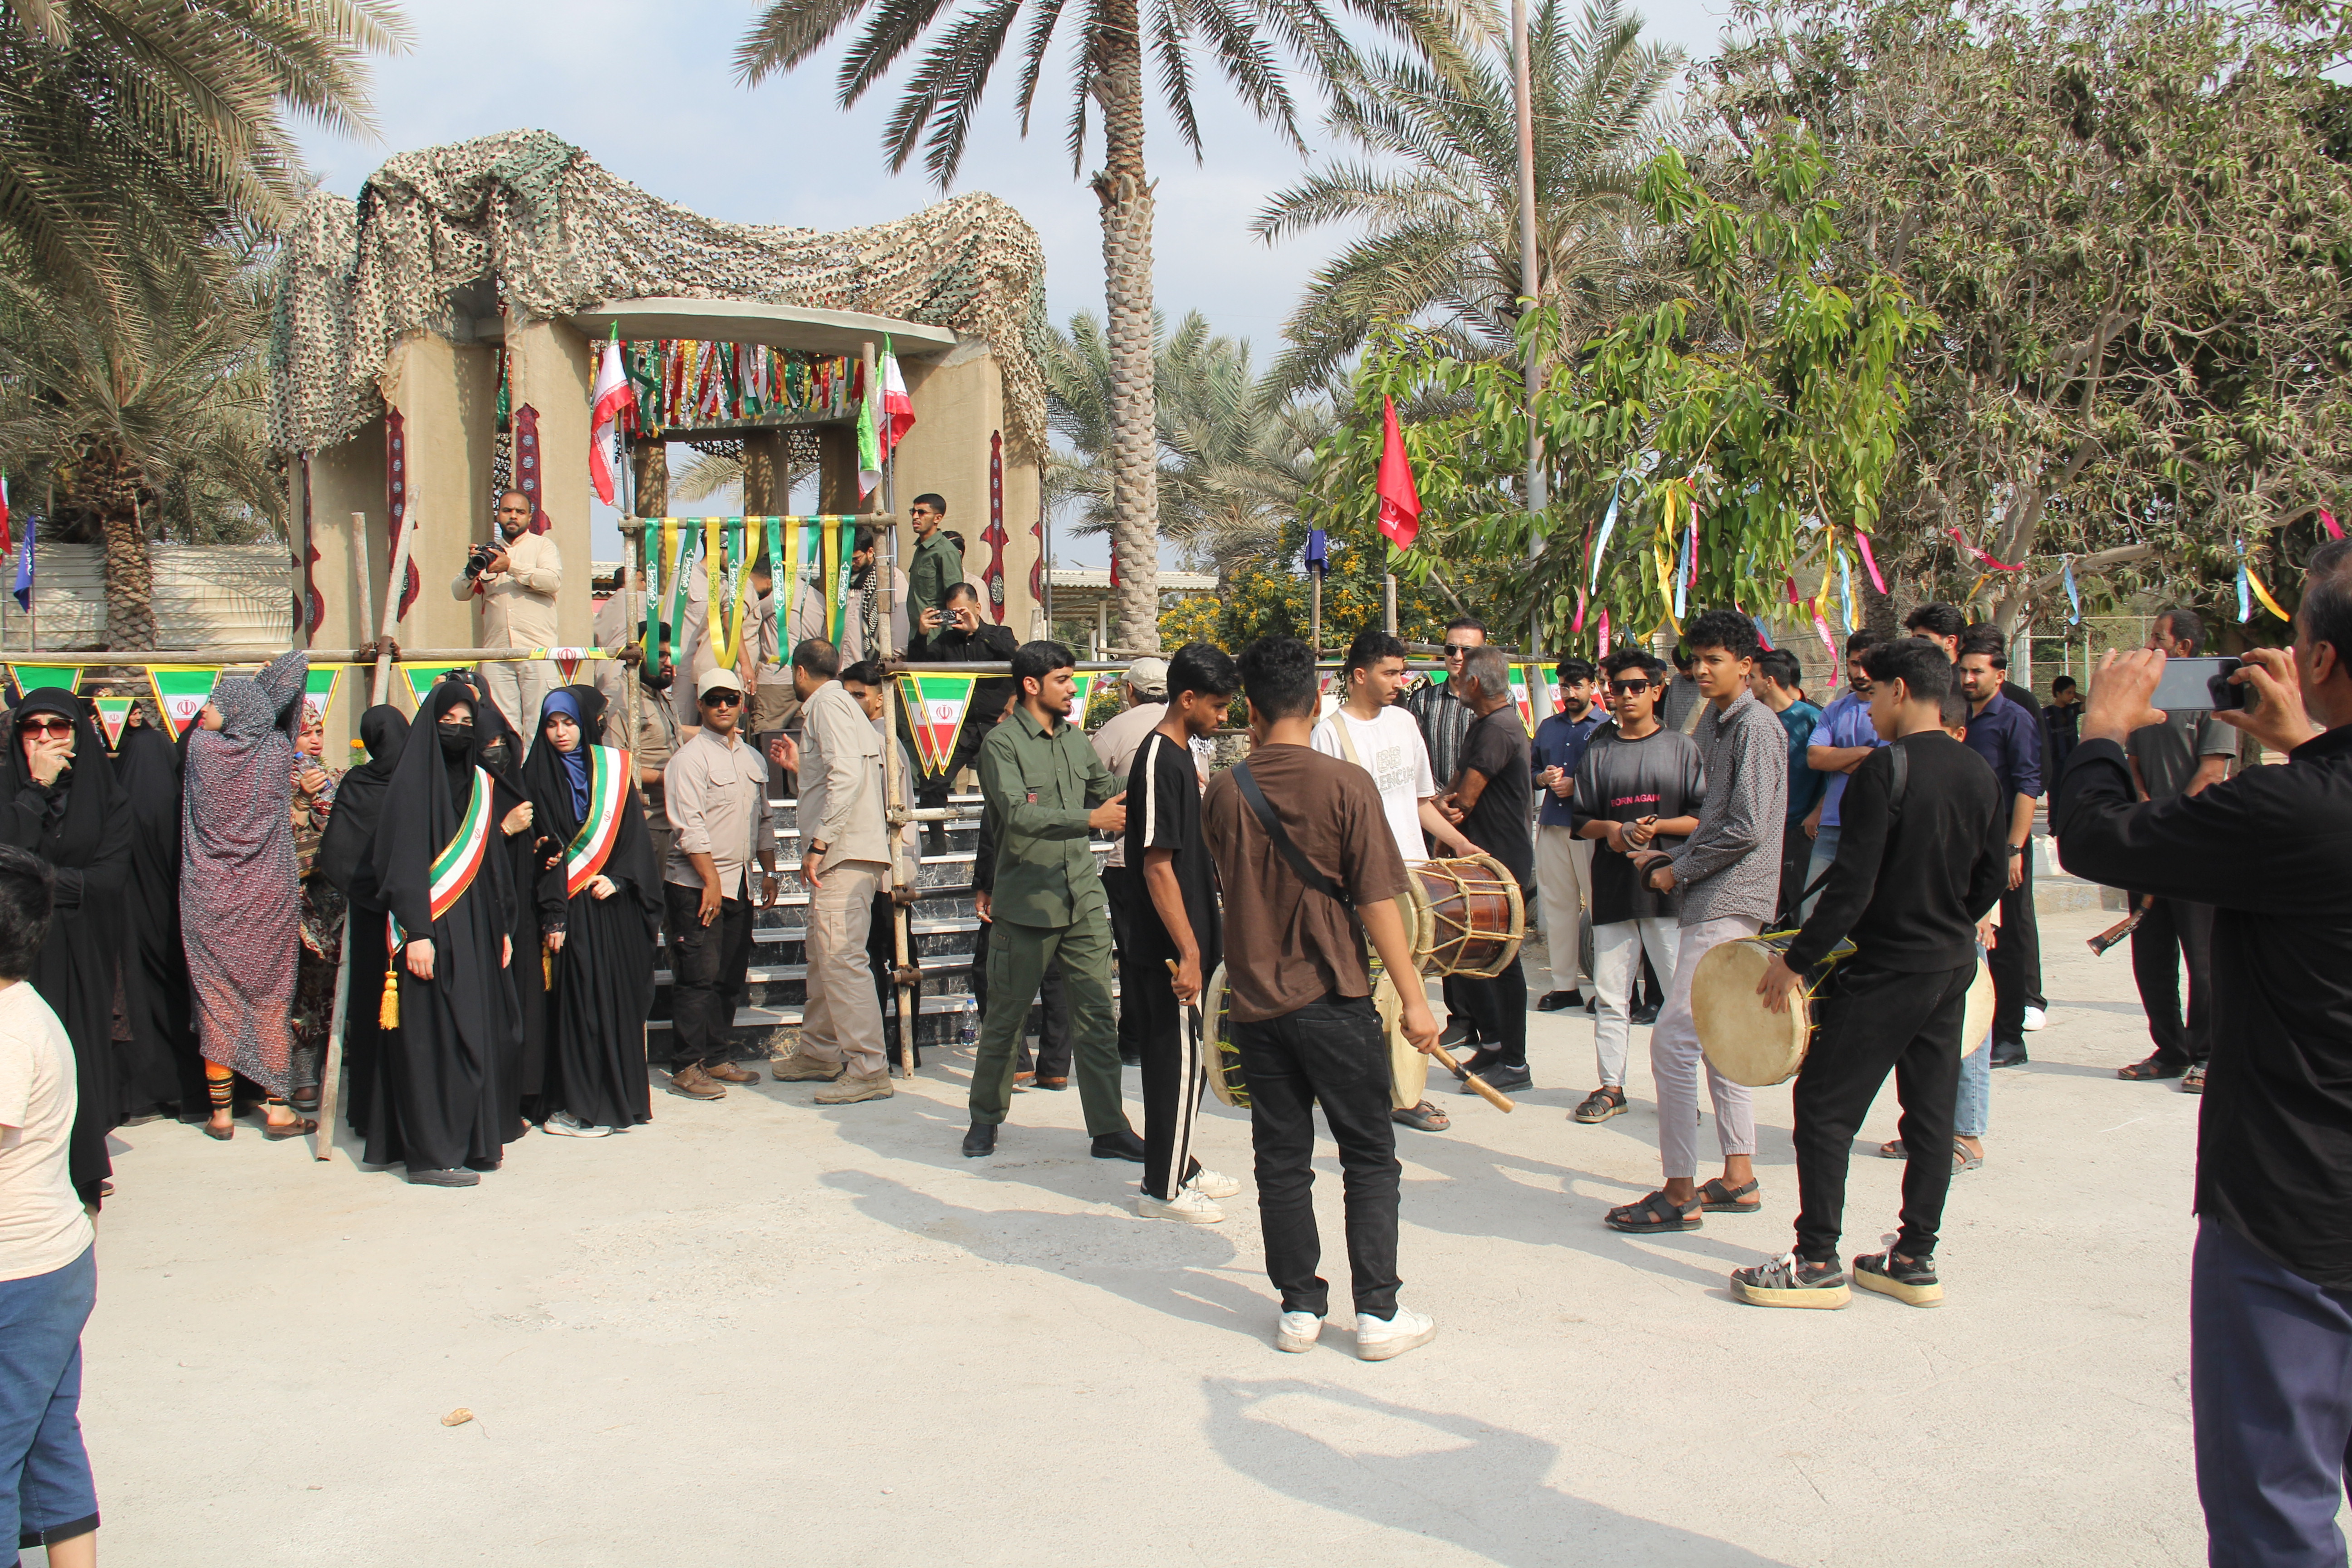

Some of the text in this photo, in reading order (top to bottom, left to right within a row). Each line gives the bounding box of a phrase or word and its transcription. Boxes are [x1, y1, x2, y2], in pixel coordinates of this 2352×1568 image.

[1376, 746, 1402, 773] BB
[1611, 794, 1660, 807] BORN AGAIN
